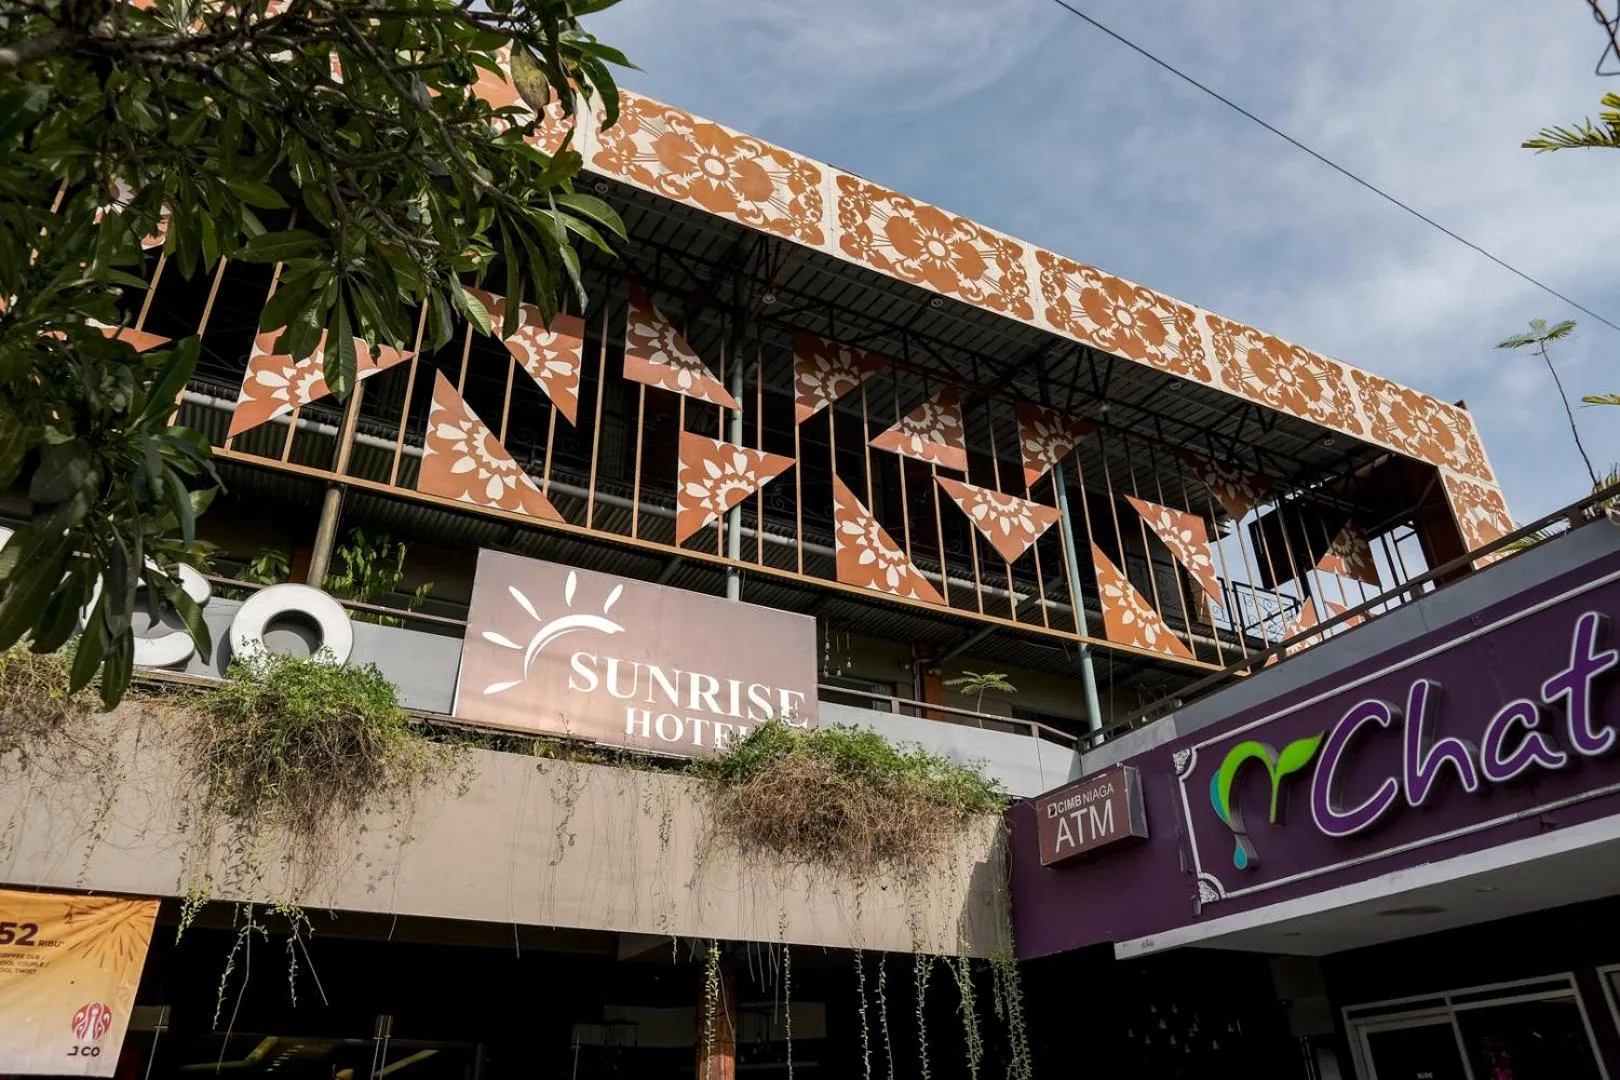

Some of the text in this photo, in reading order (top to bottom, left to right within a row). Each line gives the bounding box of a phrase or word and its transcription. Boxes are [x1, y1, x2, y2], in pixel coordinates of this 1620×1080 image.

[568, 651, 809, 729] SUNRISE
[1310, 610, 1619, 838] Chat
[1057, 782, 1114, 814] CIMB NIAGA
[1055, 799, 1115, 853] ATM
[0, 921, 39, 946] 52
